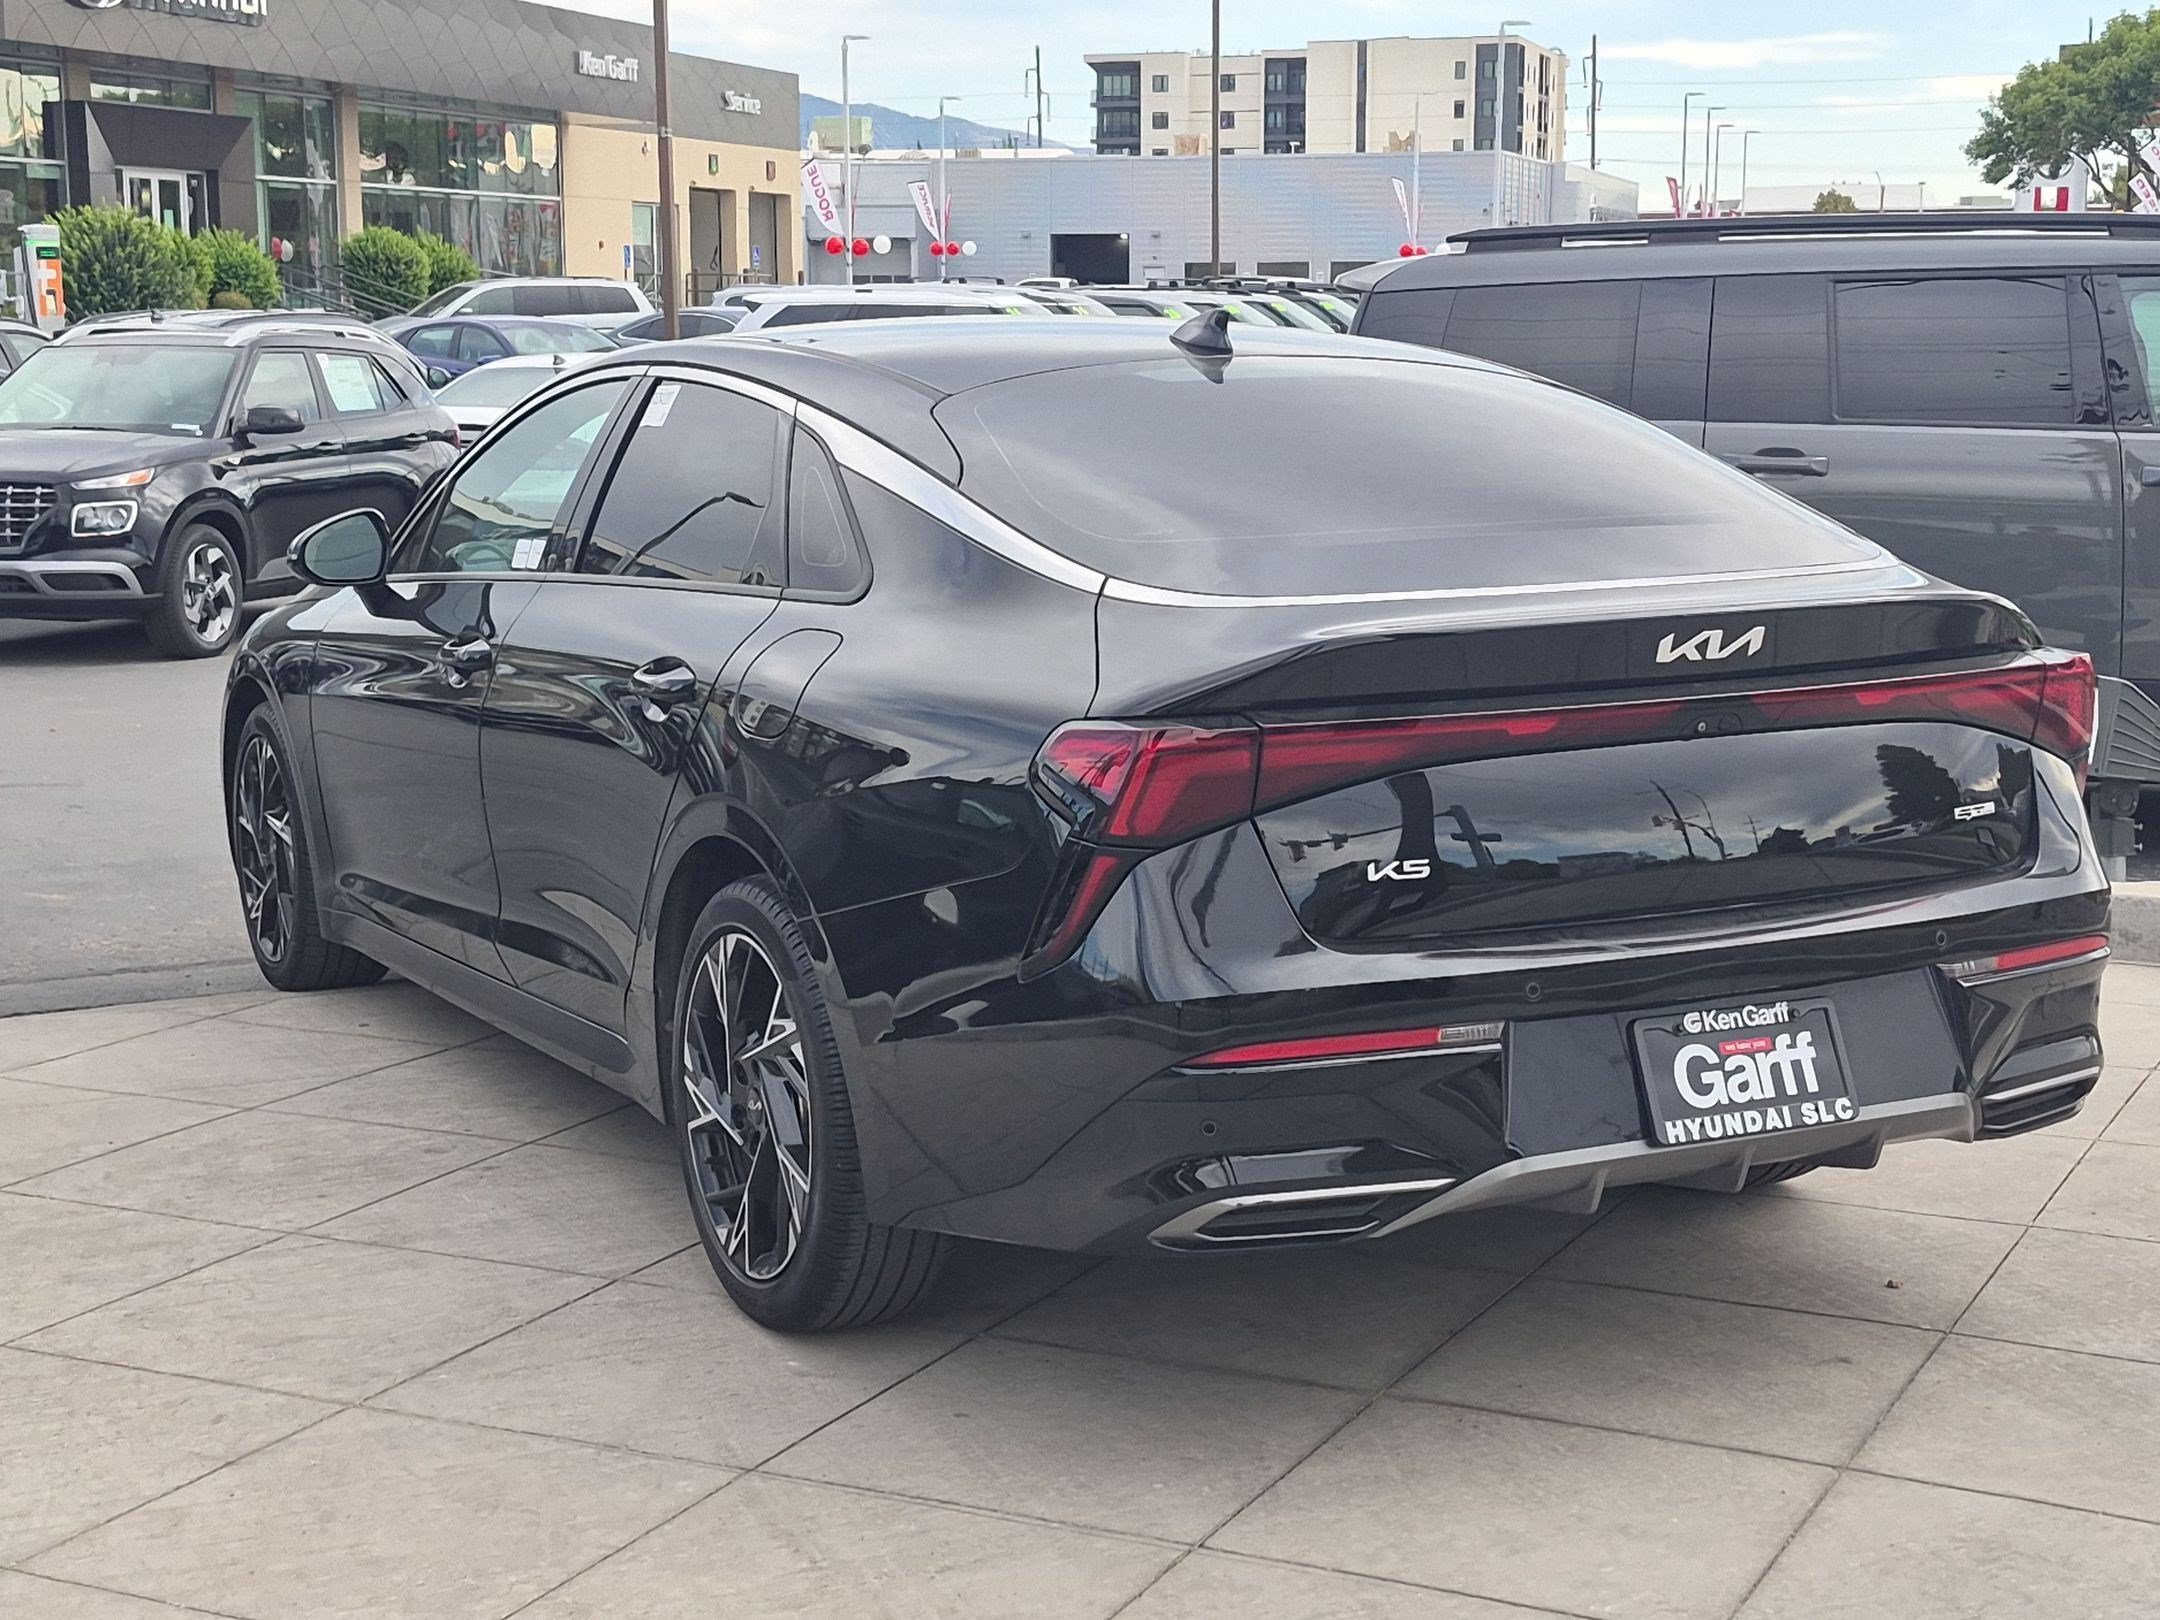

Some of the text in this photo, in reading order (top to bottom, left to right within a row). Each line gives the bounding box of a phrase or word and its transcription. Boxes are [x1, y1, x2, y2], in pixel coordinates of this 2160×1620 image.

[725, 90, 761, 115] Service
[1656, 626, 1766, 663] KIA
[1367, 858, 1431, 882] K5
[1703, 1001, 1790, 1033] Ken Garff
[1674, 1031, 1819, 1109] Garff
[1664, 1097, 1854, 1144] HYUNDAI SLC
